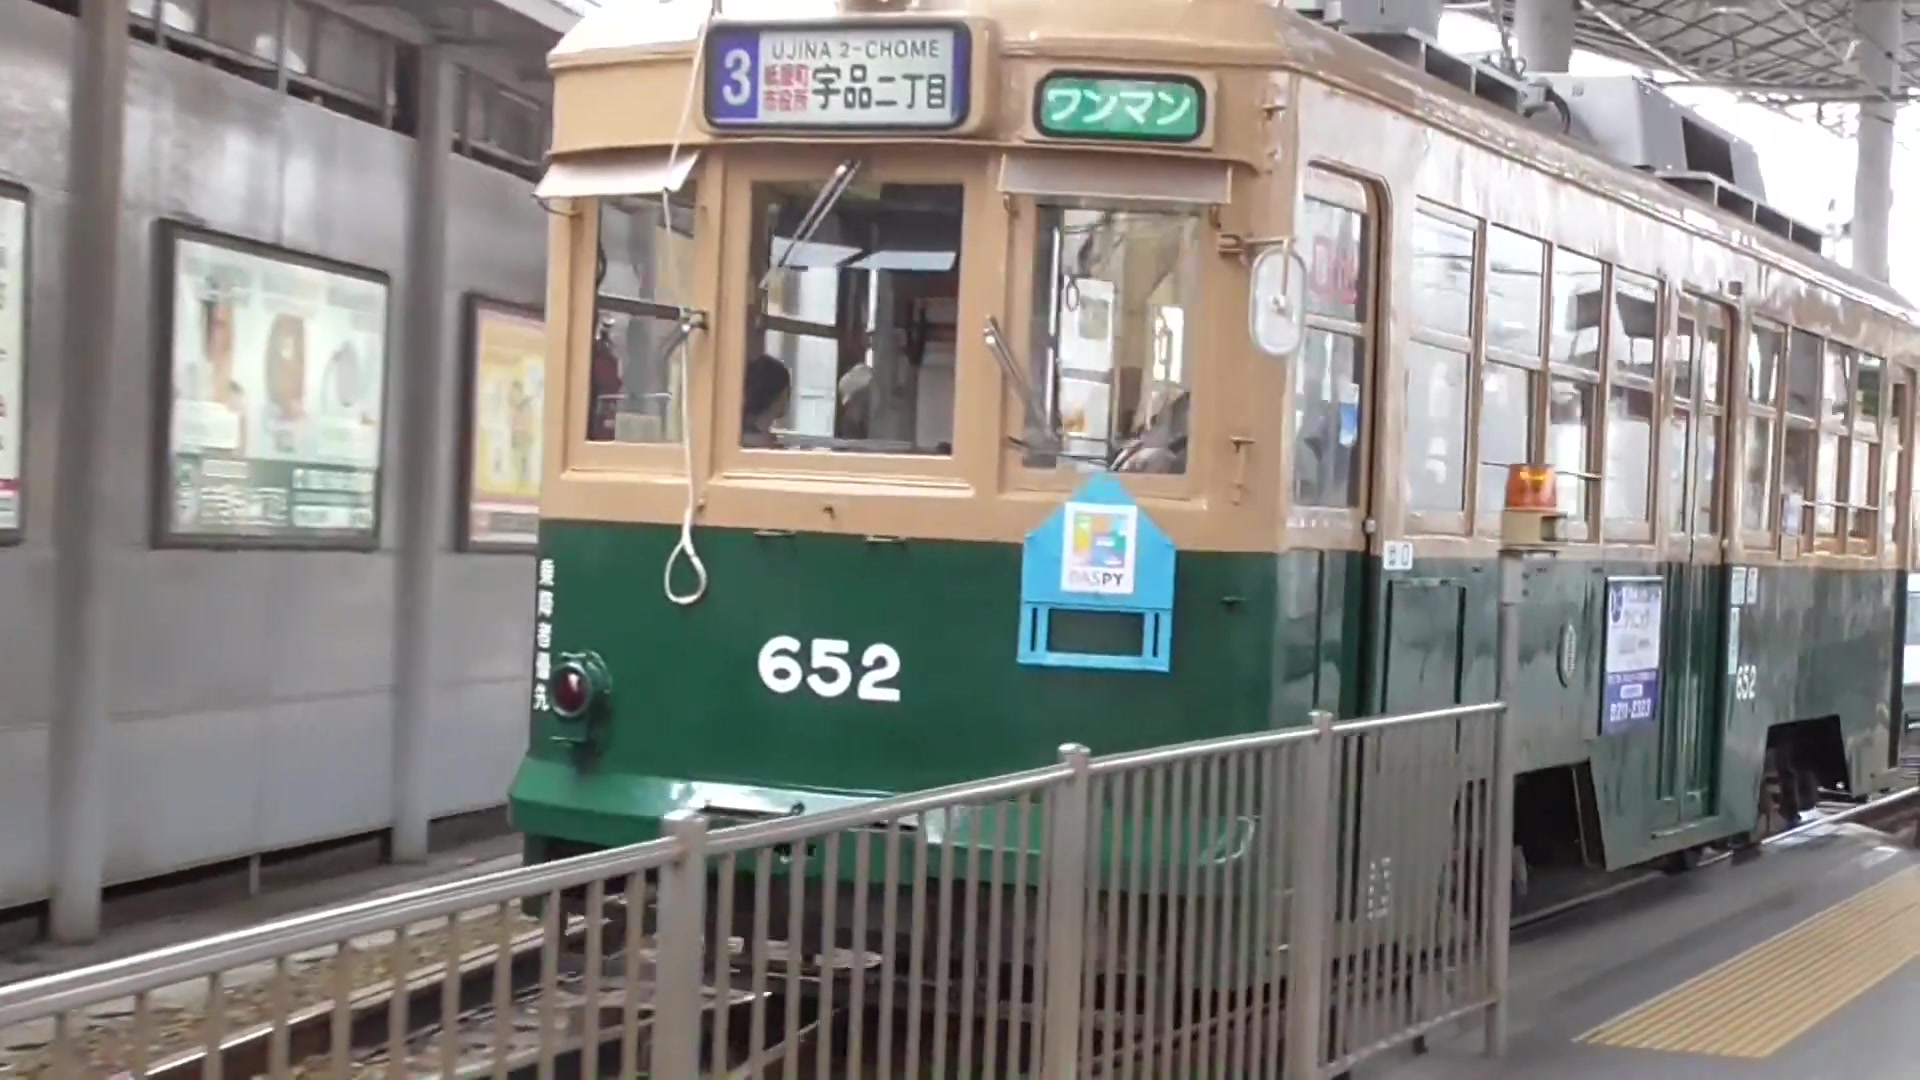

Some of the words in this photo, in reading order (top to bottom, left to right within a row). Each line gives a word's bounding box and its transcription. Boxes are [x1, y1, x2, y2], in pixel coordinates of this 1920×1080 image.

[772, 39, 831, 60] UJINA
[839, 39, 941, 60] 2-CHOME
[722, 48, 752, 106] 3
[811, 63, 946, 110] 宇品二丁目
[1047, 88, 1191, 125] ワンマン
[1069, 570, 1124, 587] PASPY
[757, 634, 902, 702] 652
[1735, 664, 1757, 700] 652
